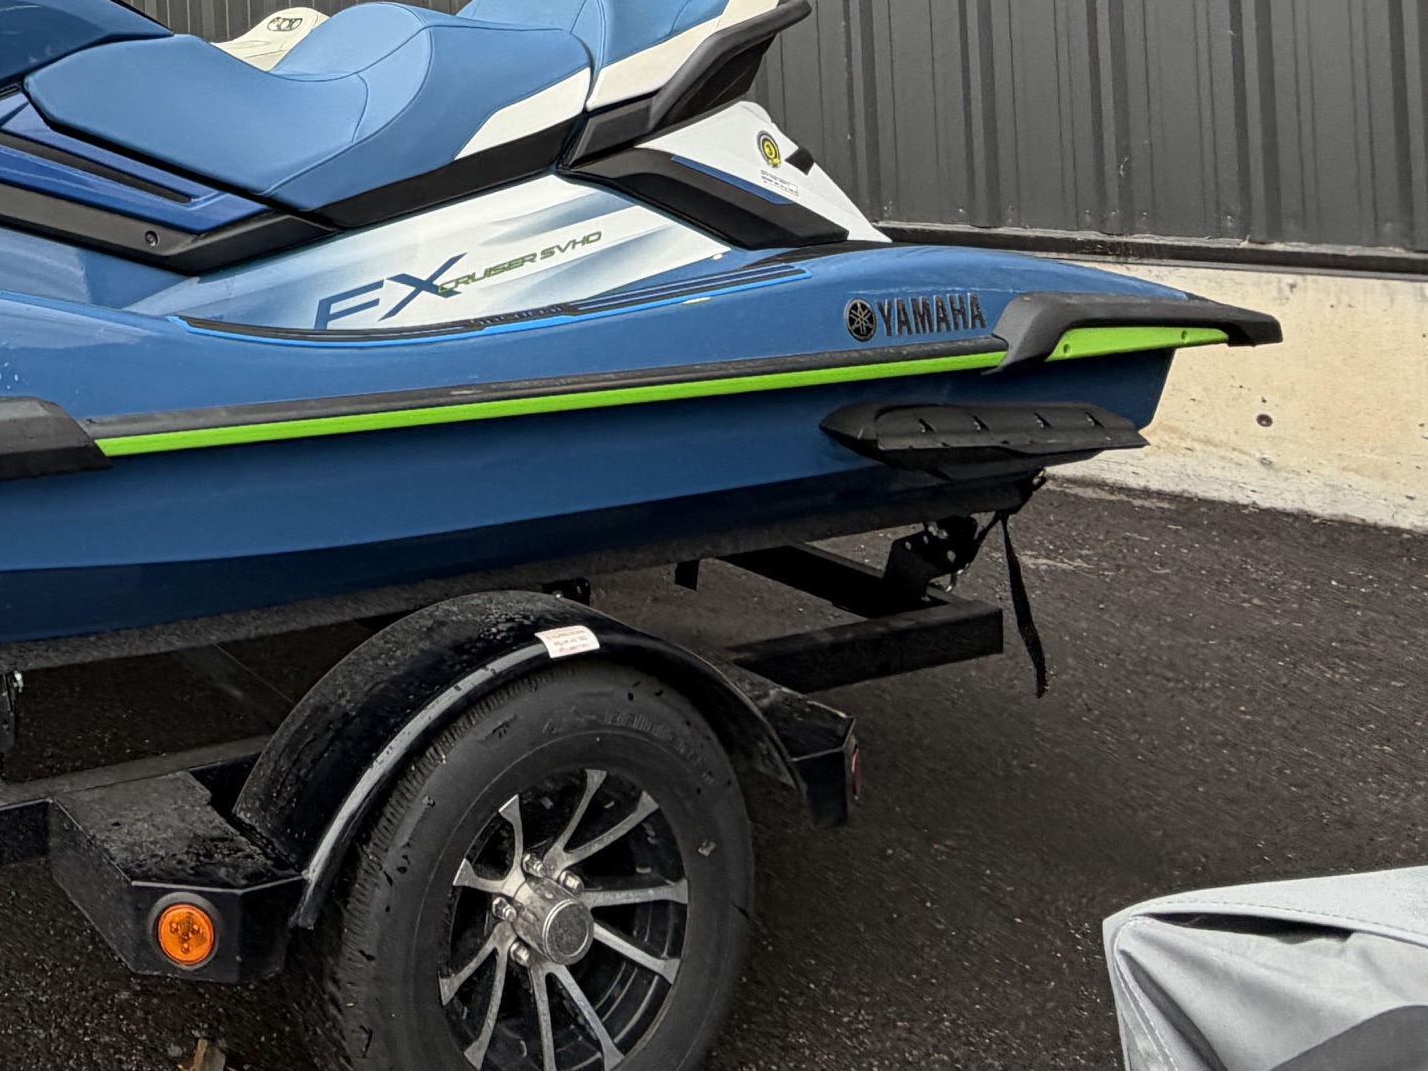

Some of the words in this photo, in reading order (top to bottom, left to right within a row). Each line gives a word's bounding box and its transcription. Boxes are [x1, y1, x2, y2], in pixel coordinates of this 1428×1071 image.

[314, 251, 468, 330] FX
[438, 252, 537, 293] CRUISER
[540, 231, 603, 260] SVHO
[876, 292, 987, 337] YAMAHA
